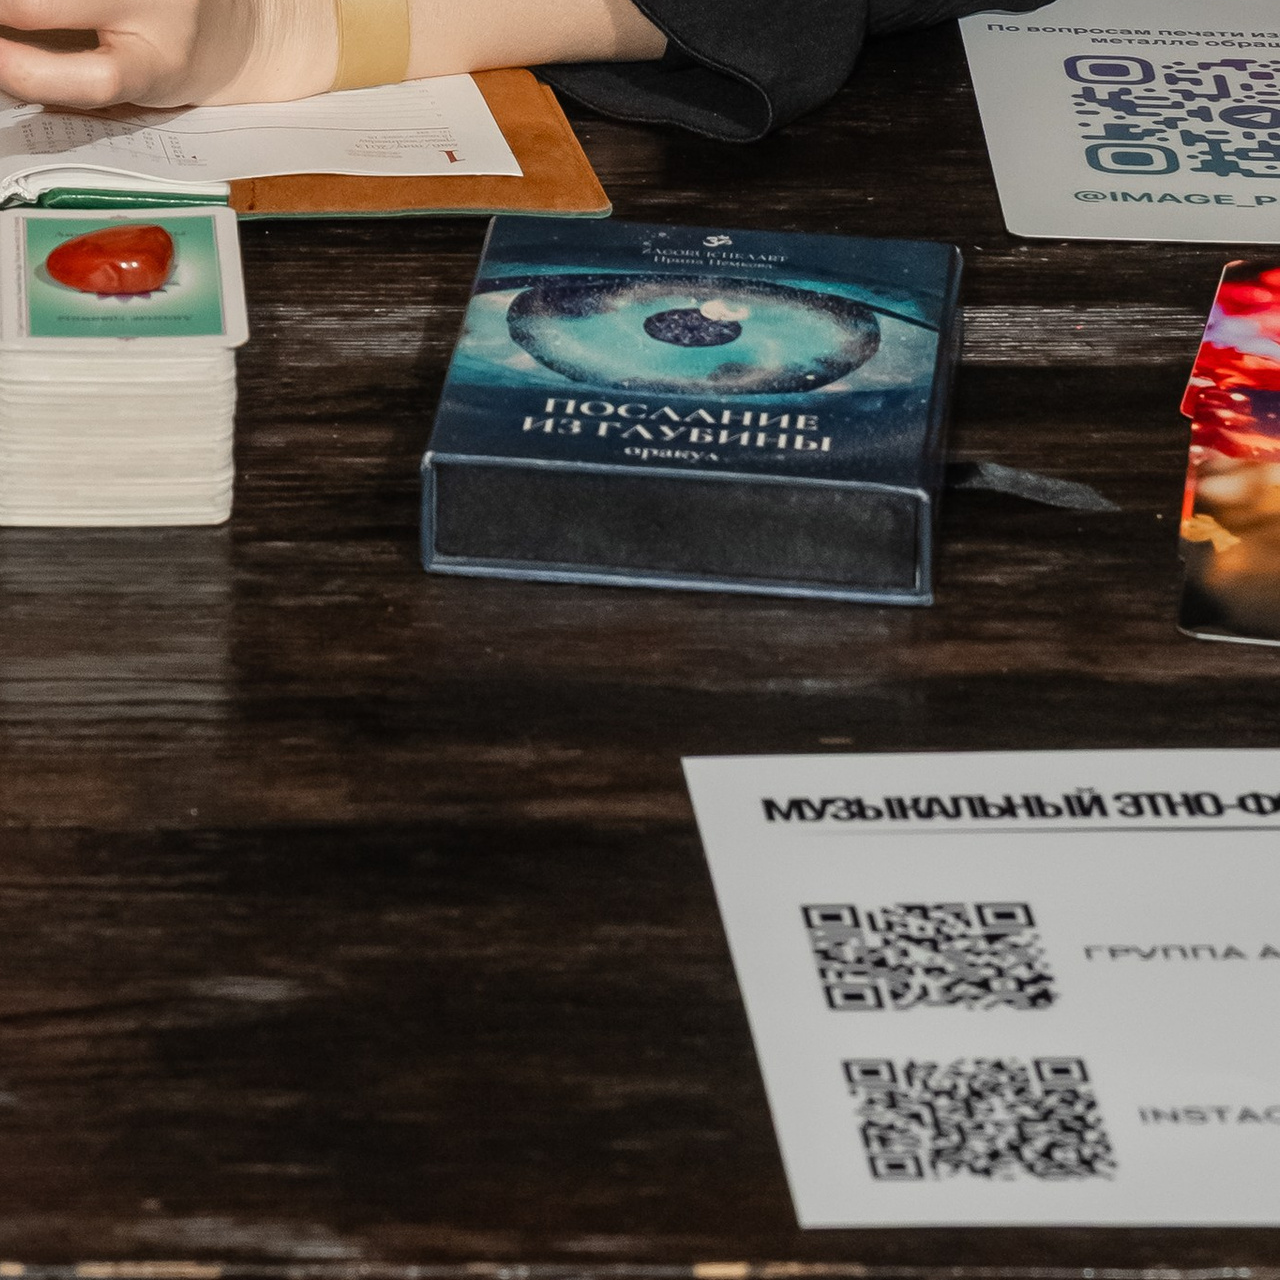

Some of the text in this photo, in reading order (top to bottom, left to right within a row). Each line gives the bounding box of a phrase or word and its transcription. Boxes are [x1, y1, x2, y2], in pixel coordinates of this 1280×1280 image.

[986, 23, 1020, 33] По
[1026, 26, 1151, 36] вопросам
[1158, 30, 1244, 38] печати
[1090, 37, 1200, 47] металле
[438, 149, 466, 164] 1
[1073, 190, 1278, 208] @IMAGE_P
[544, 397, 820, 432] ПОСЛАНИЕ
[522, 415, 832, 453] ИЗ ГЛУБИНЫ
[760, 786, 1280, 823] МУЗЫКАЛЬНЫЙ ЭТНО-Ф
[1083, 943, 1249, 961] ГРУППА
